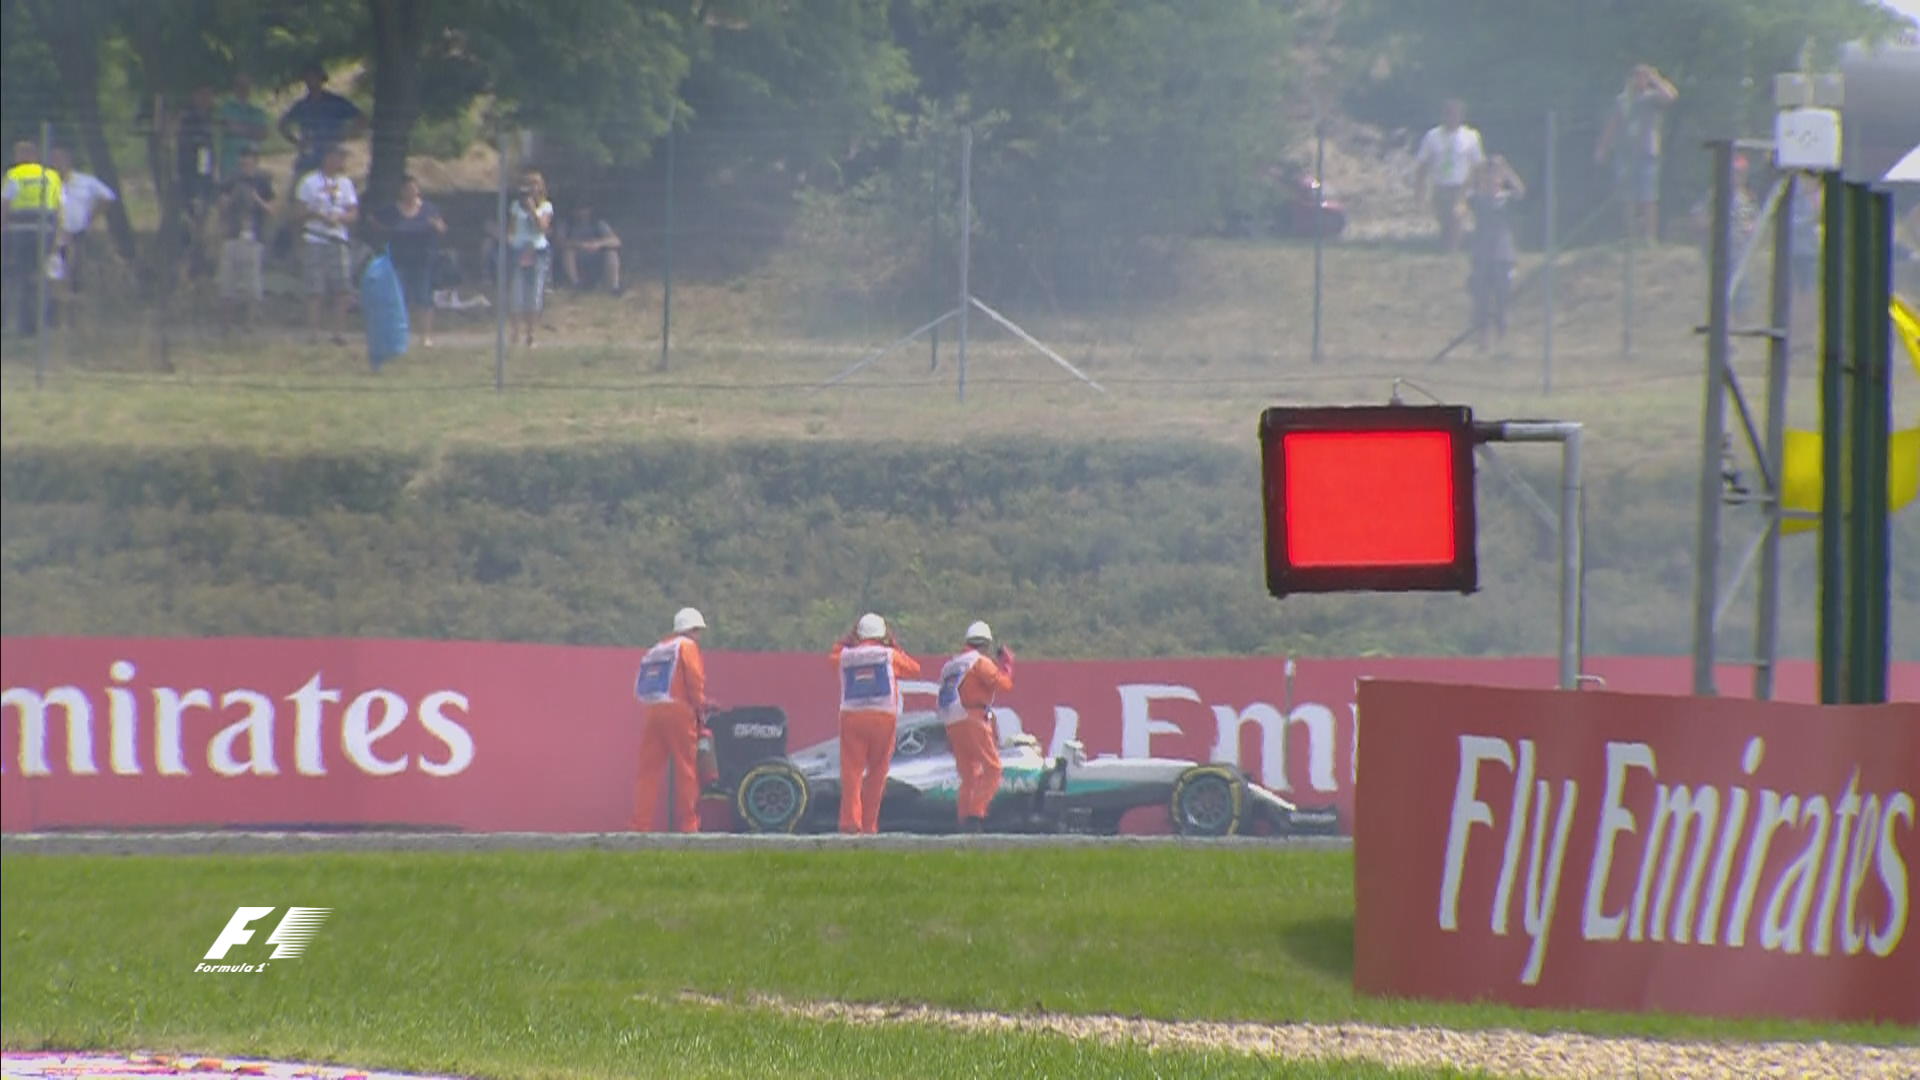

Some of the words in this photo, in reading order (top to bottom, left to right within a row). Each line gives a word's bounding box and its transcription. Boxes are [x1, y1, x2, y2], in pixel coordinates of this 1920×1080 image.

[1, 661, 476, 777] mirates
[1439, 735, 1579, 985] Fly
[1582, 736, 1915, 957] Emirates
